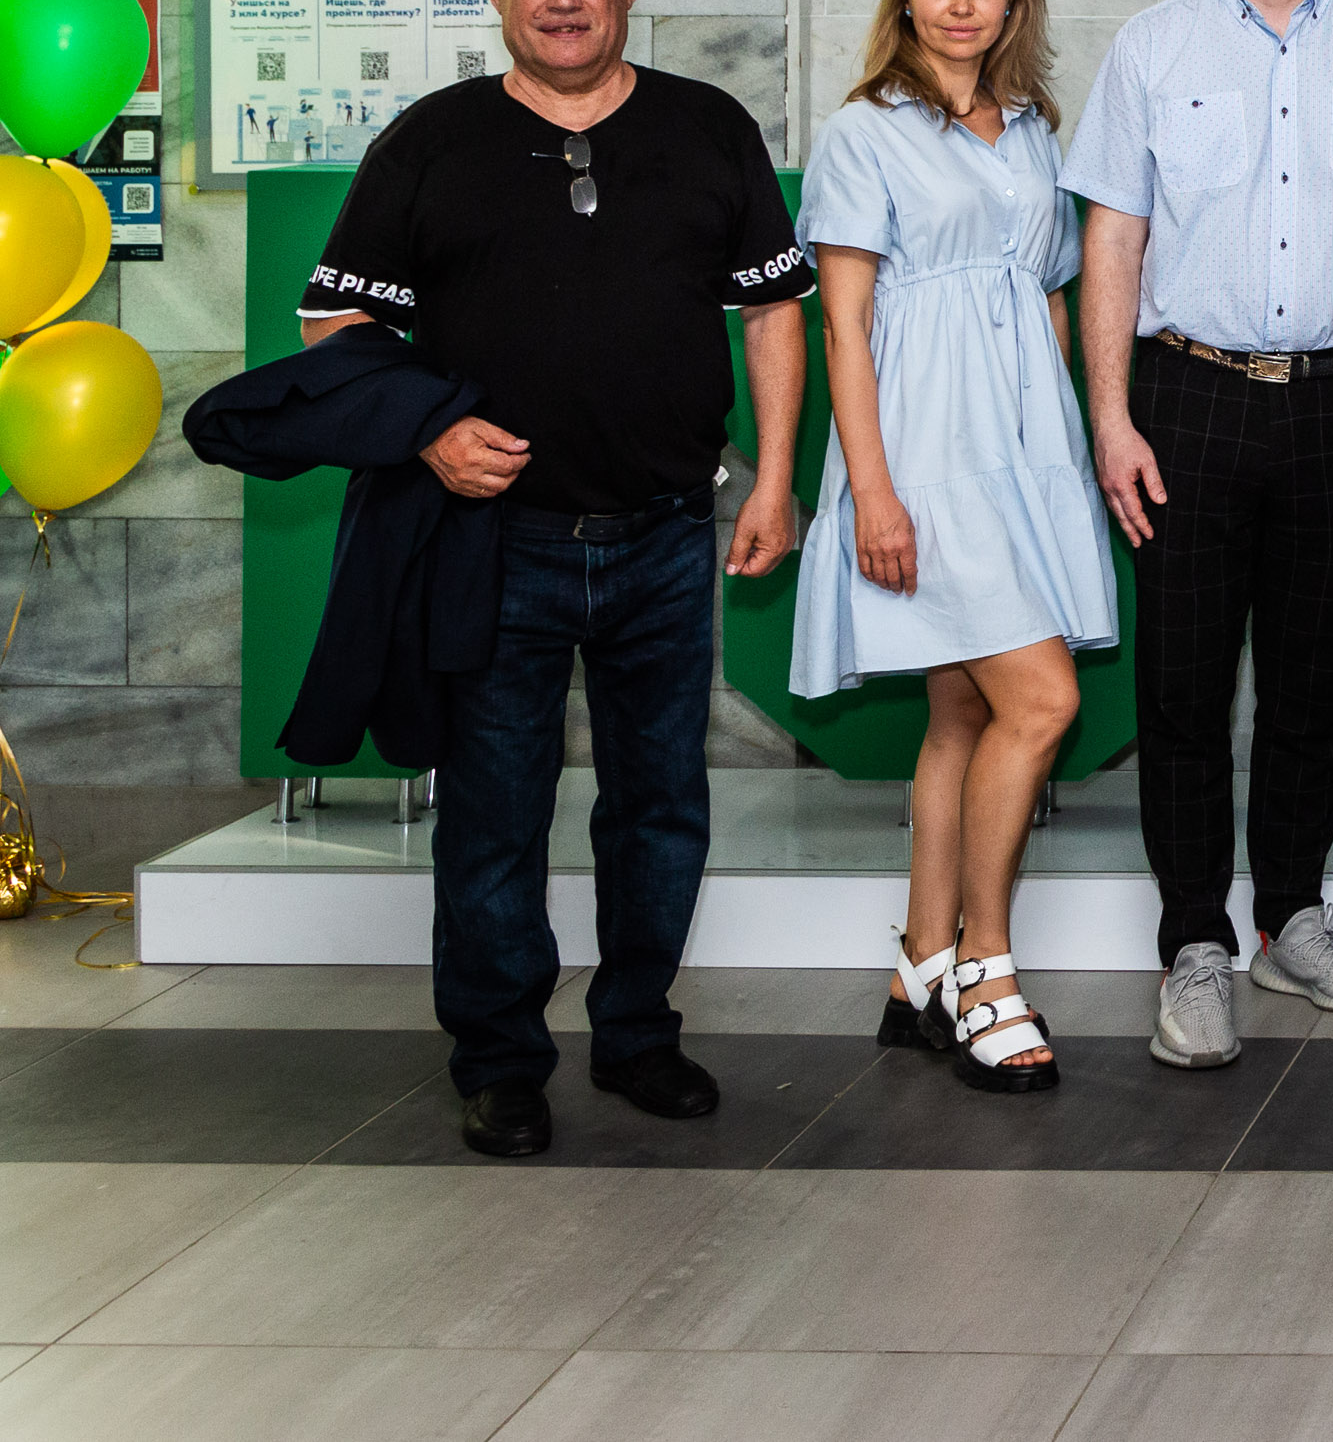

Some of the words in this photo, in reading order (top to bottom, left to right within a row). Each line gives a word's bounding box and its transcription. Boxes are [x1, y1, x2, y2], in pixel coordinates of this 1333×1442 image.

[270, 9, 306, 18] курсе?
[326, 9, 363, 17] пройти
[366, 8, 421, 18] практику?
[433, 7, 484, 17] работать!
[308, 264, 338, 288] IFE
[338, 273, 416, 307] PLEAS
